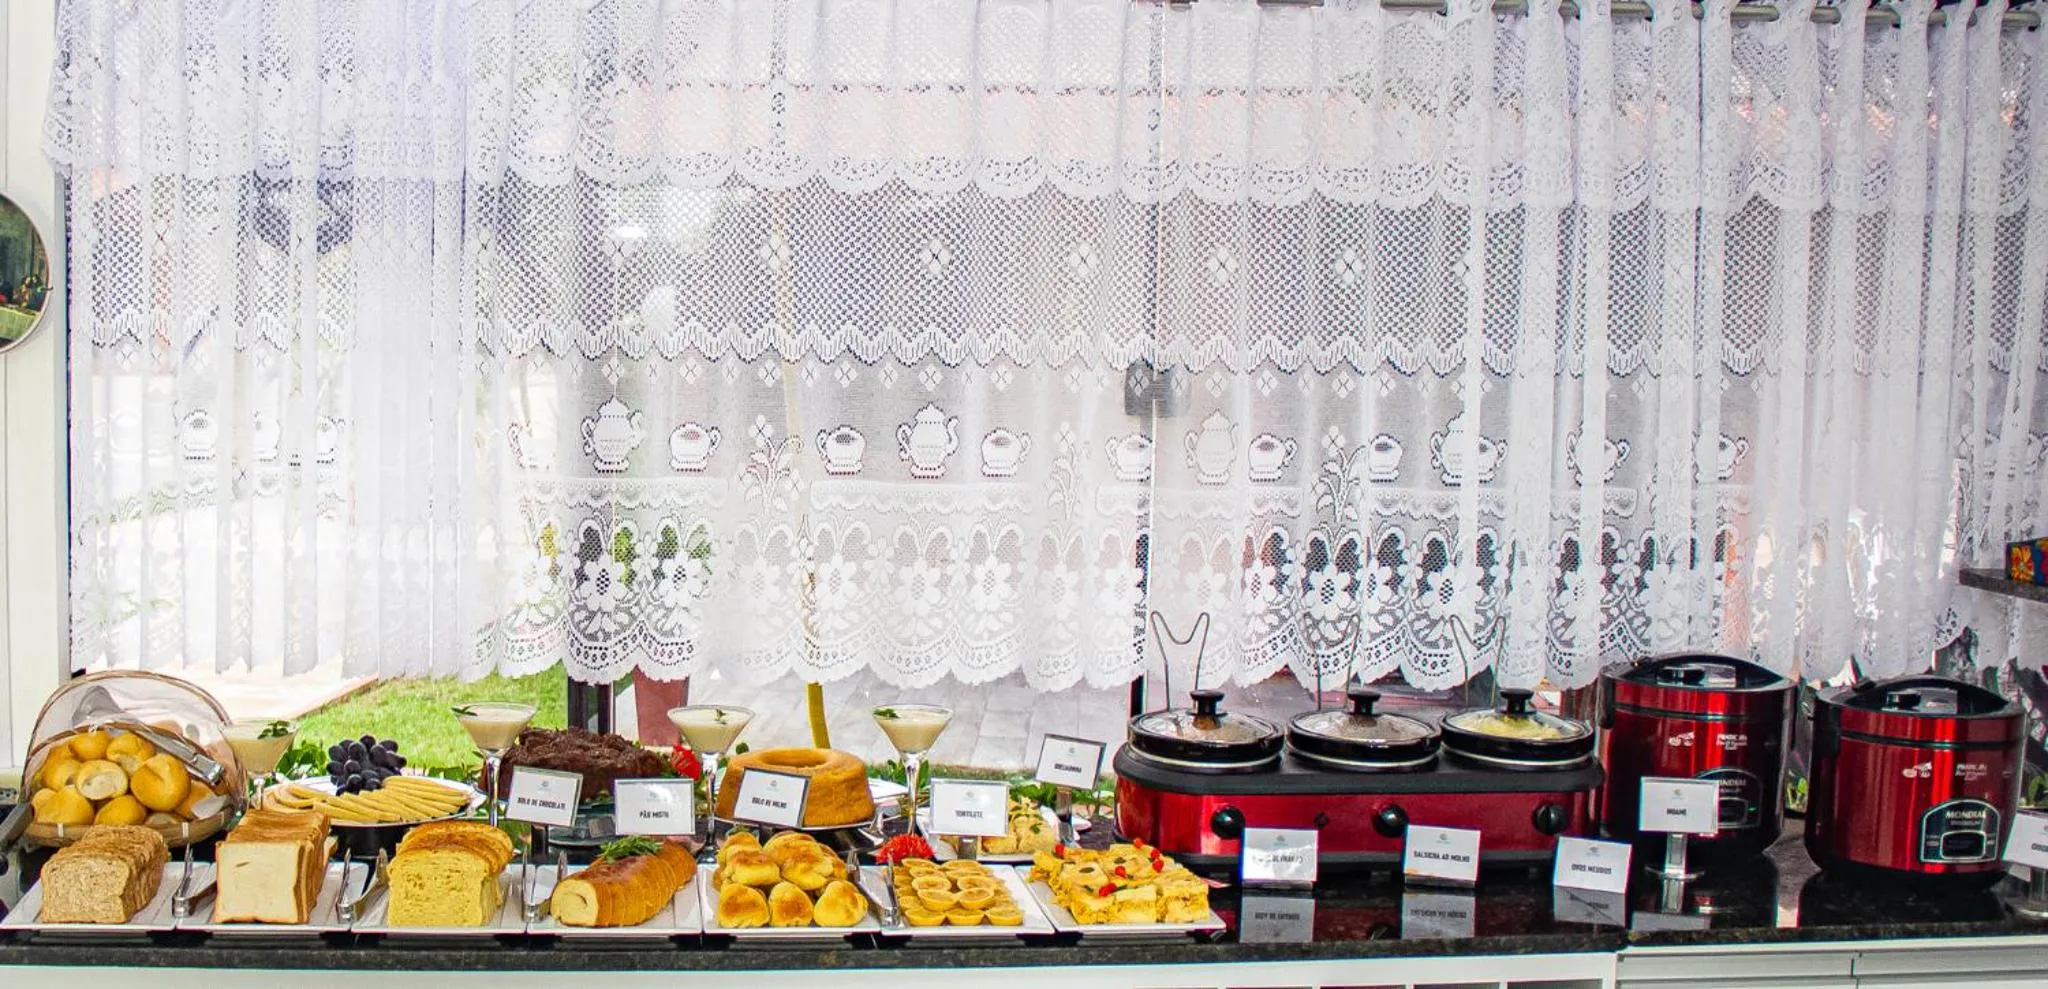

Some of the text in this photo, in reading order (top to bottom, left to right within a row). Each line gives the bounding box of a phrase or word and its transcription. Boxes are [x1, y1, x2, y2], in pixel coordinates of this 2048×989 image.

[517, 797, 530, 806] BOLO
[531, 799, 538, 807] DE
[752, 797, 765, 806] BOLO
[1945, 810, 1987, 819] MONDIAL
[1571, 863, 1612, 875] OVOS MEXIDOS
